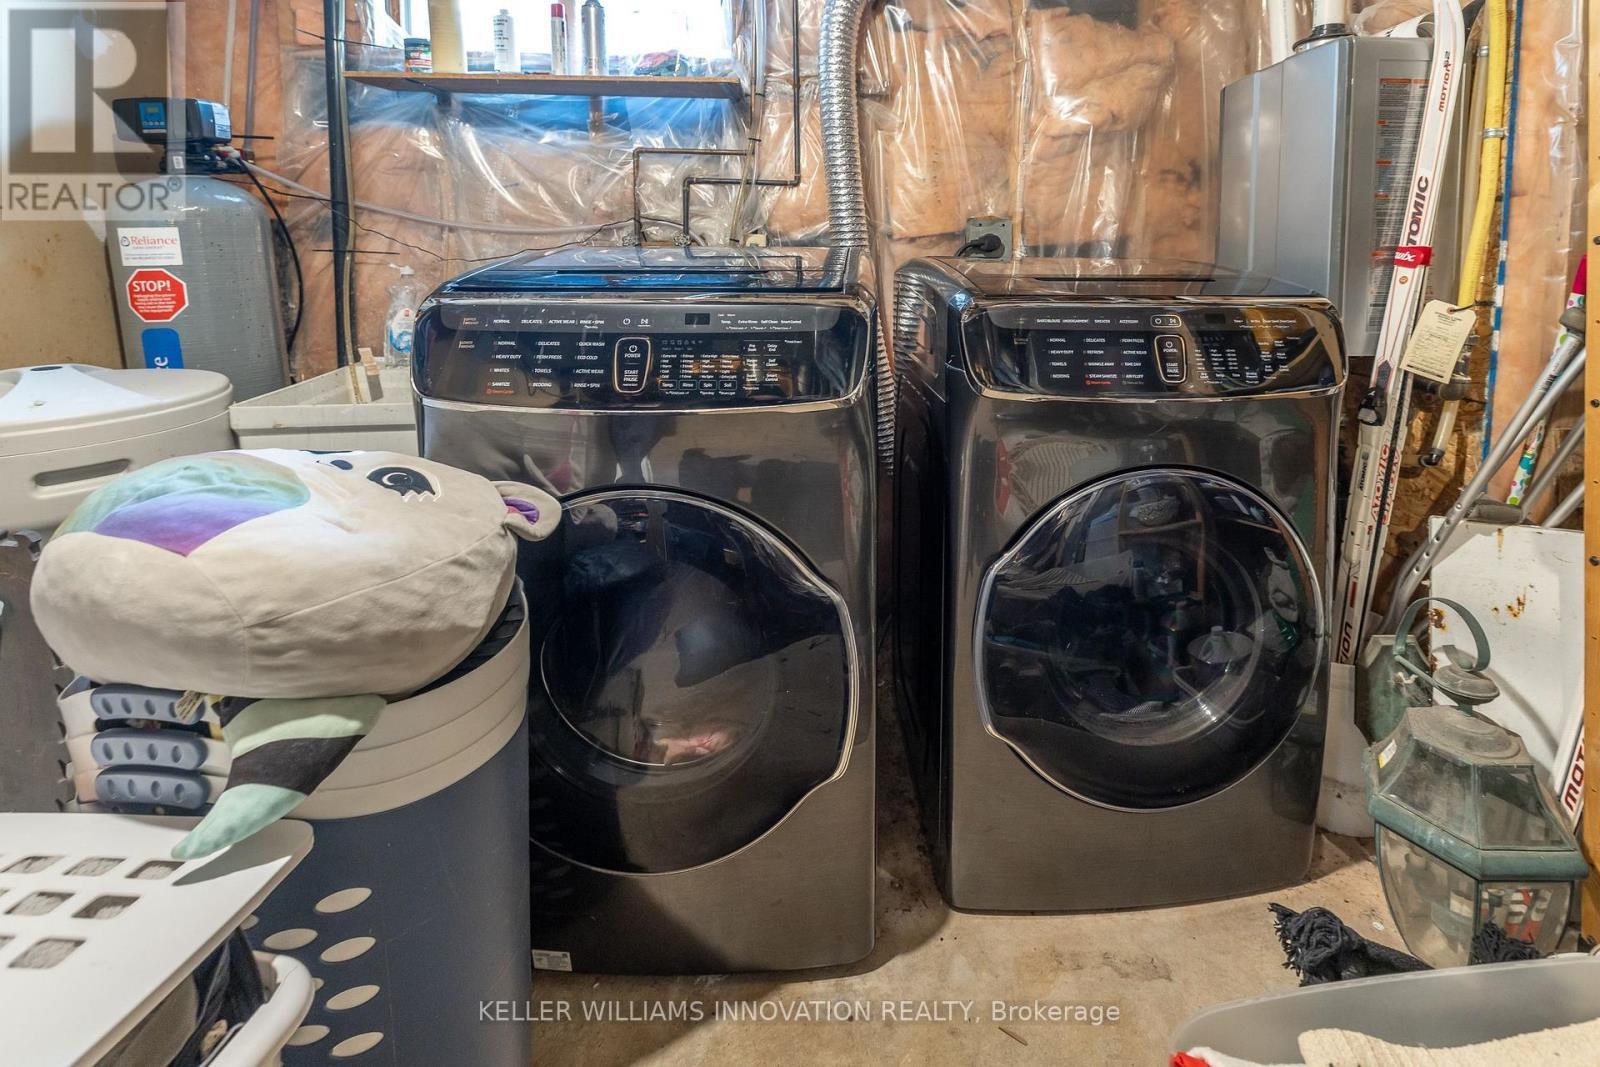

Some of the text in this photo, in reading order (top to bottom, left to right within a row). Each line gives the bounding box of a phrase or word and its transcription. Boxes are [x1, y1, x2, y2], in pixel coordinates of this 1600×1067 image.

[1406, 176, 1429, 246] TOMIC
[130, 236, 177, 245] Reliance
[1395, 252, 1416, 262] wix
[132, 280, 171, 292] STOP!
[1565, 738, 1584, 812] MOT
